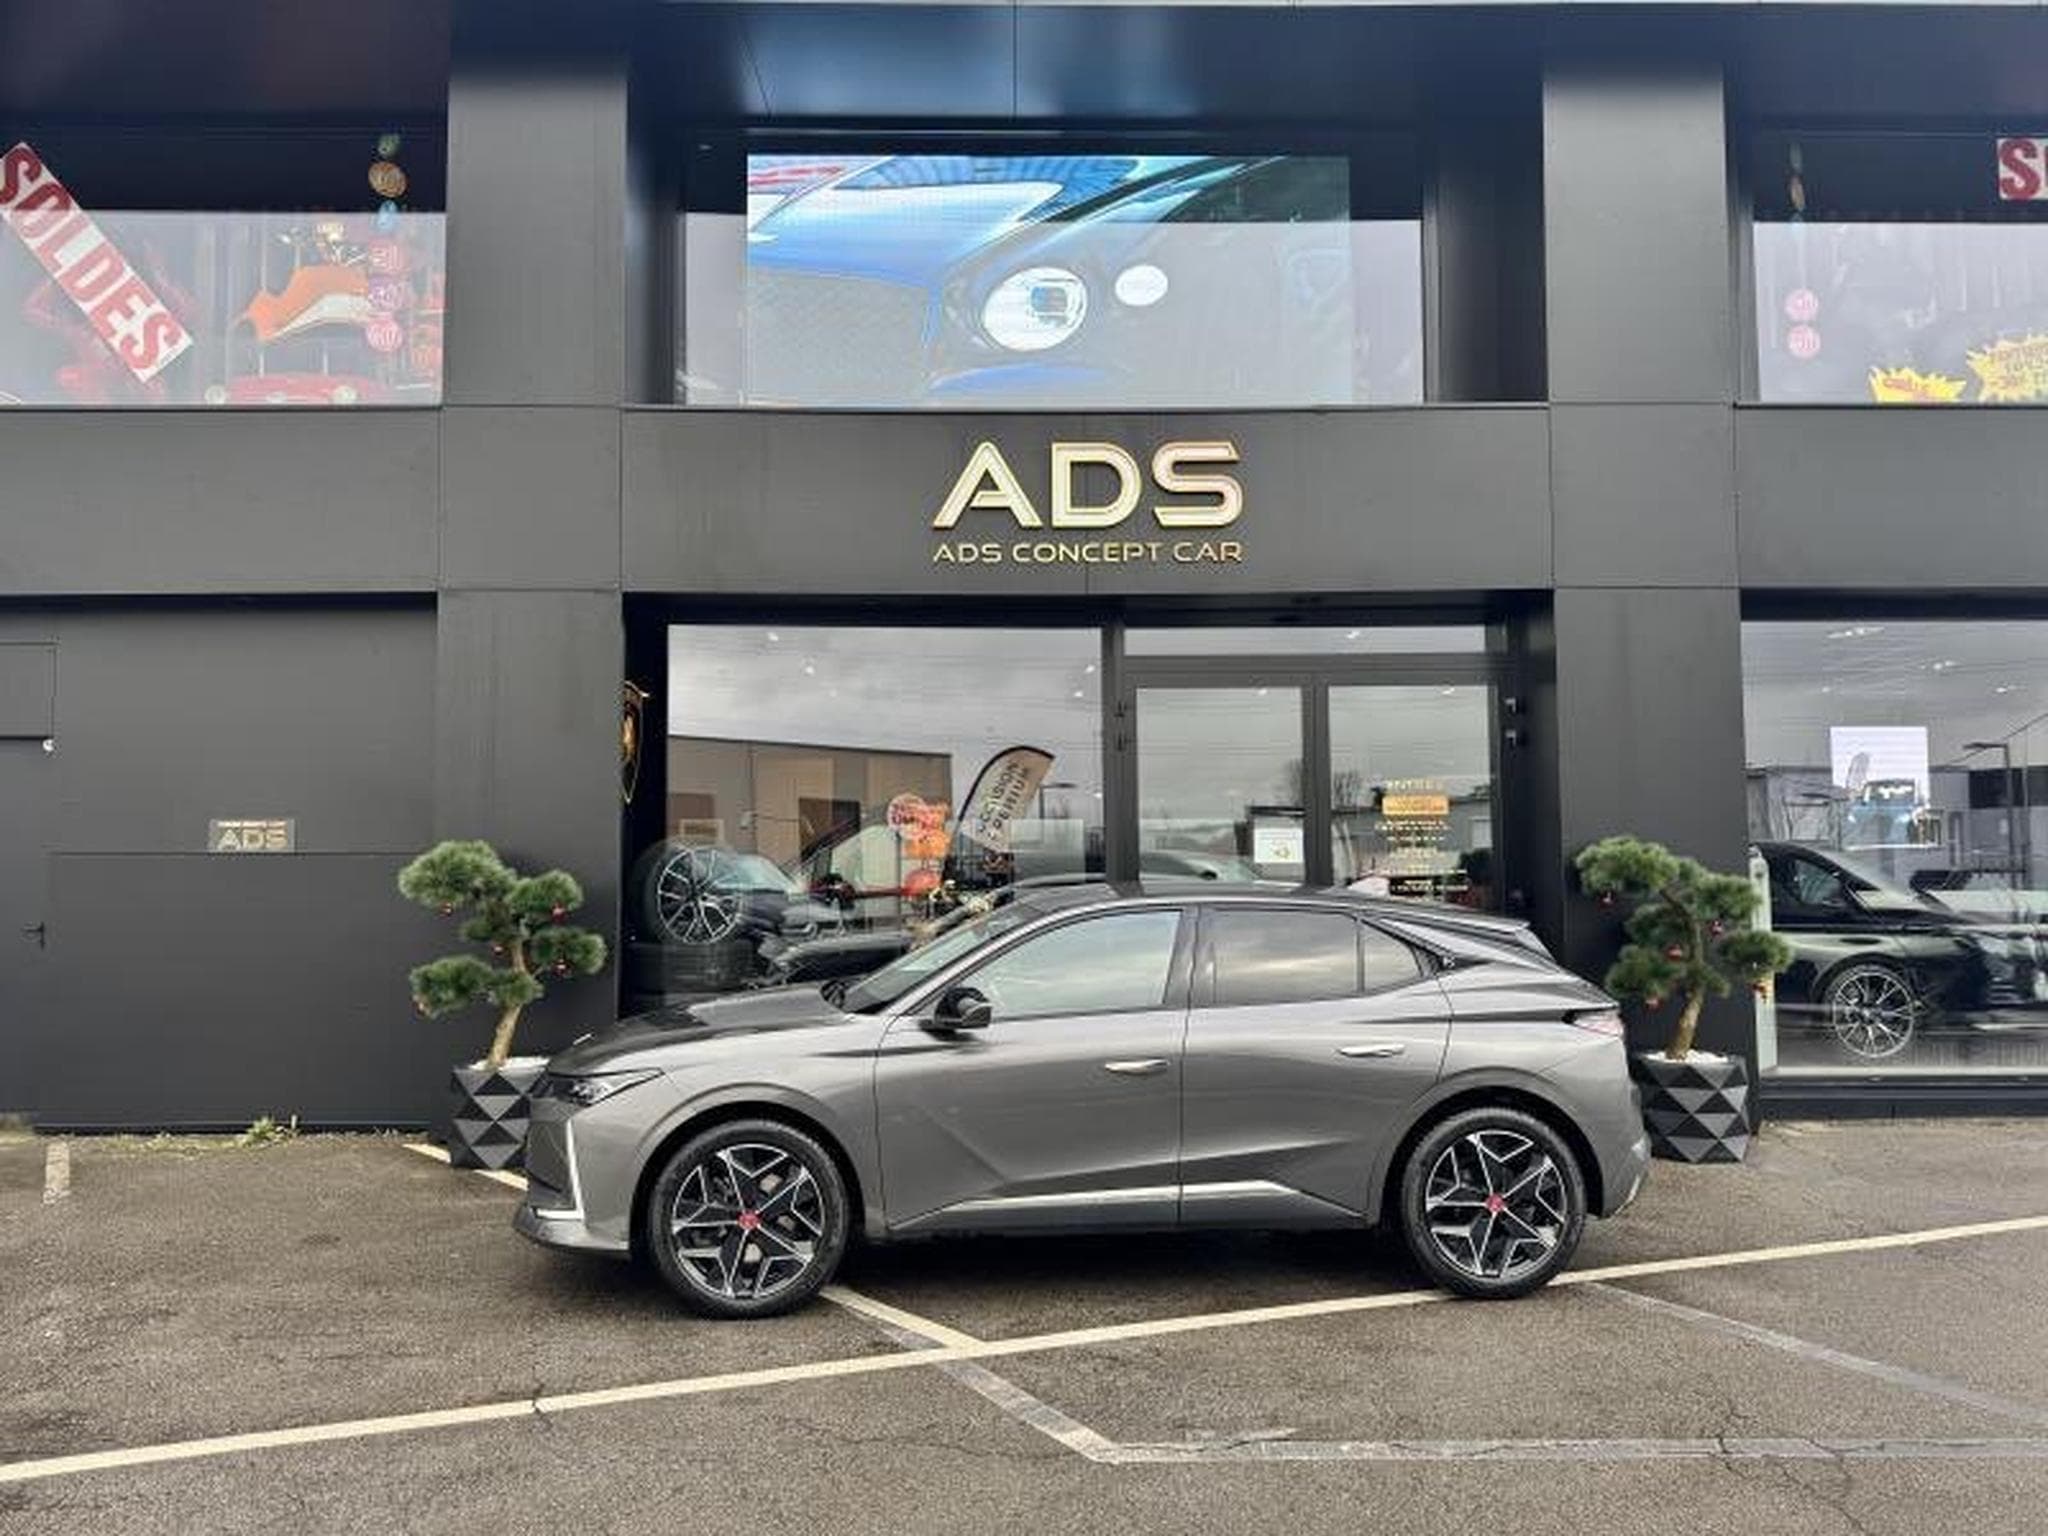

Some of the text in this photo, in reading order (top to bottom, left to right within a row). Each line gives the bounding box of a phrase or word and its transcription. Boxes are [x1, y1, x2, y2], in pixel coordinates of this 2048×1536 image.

[2000, 139, 2048, 199] S
[0, 147, 182, 369] SOLDES
[932, 441, 1243, 528] ADS
[932, 541, 1243, 563] ADS CONCEPT CAR
[218, 827, 287, 850] ADS
